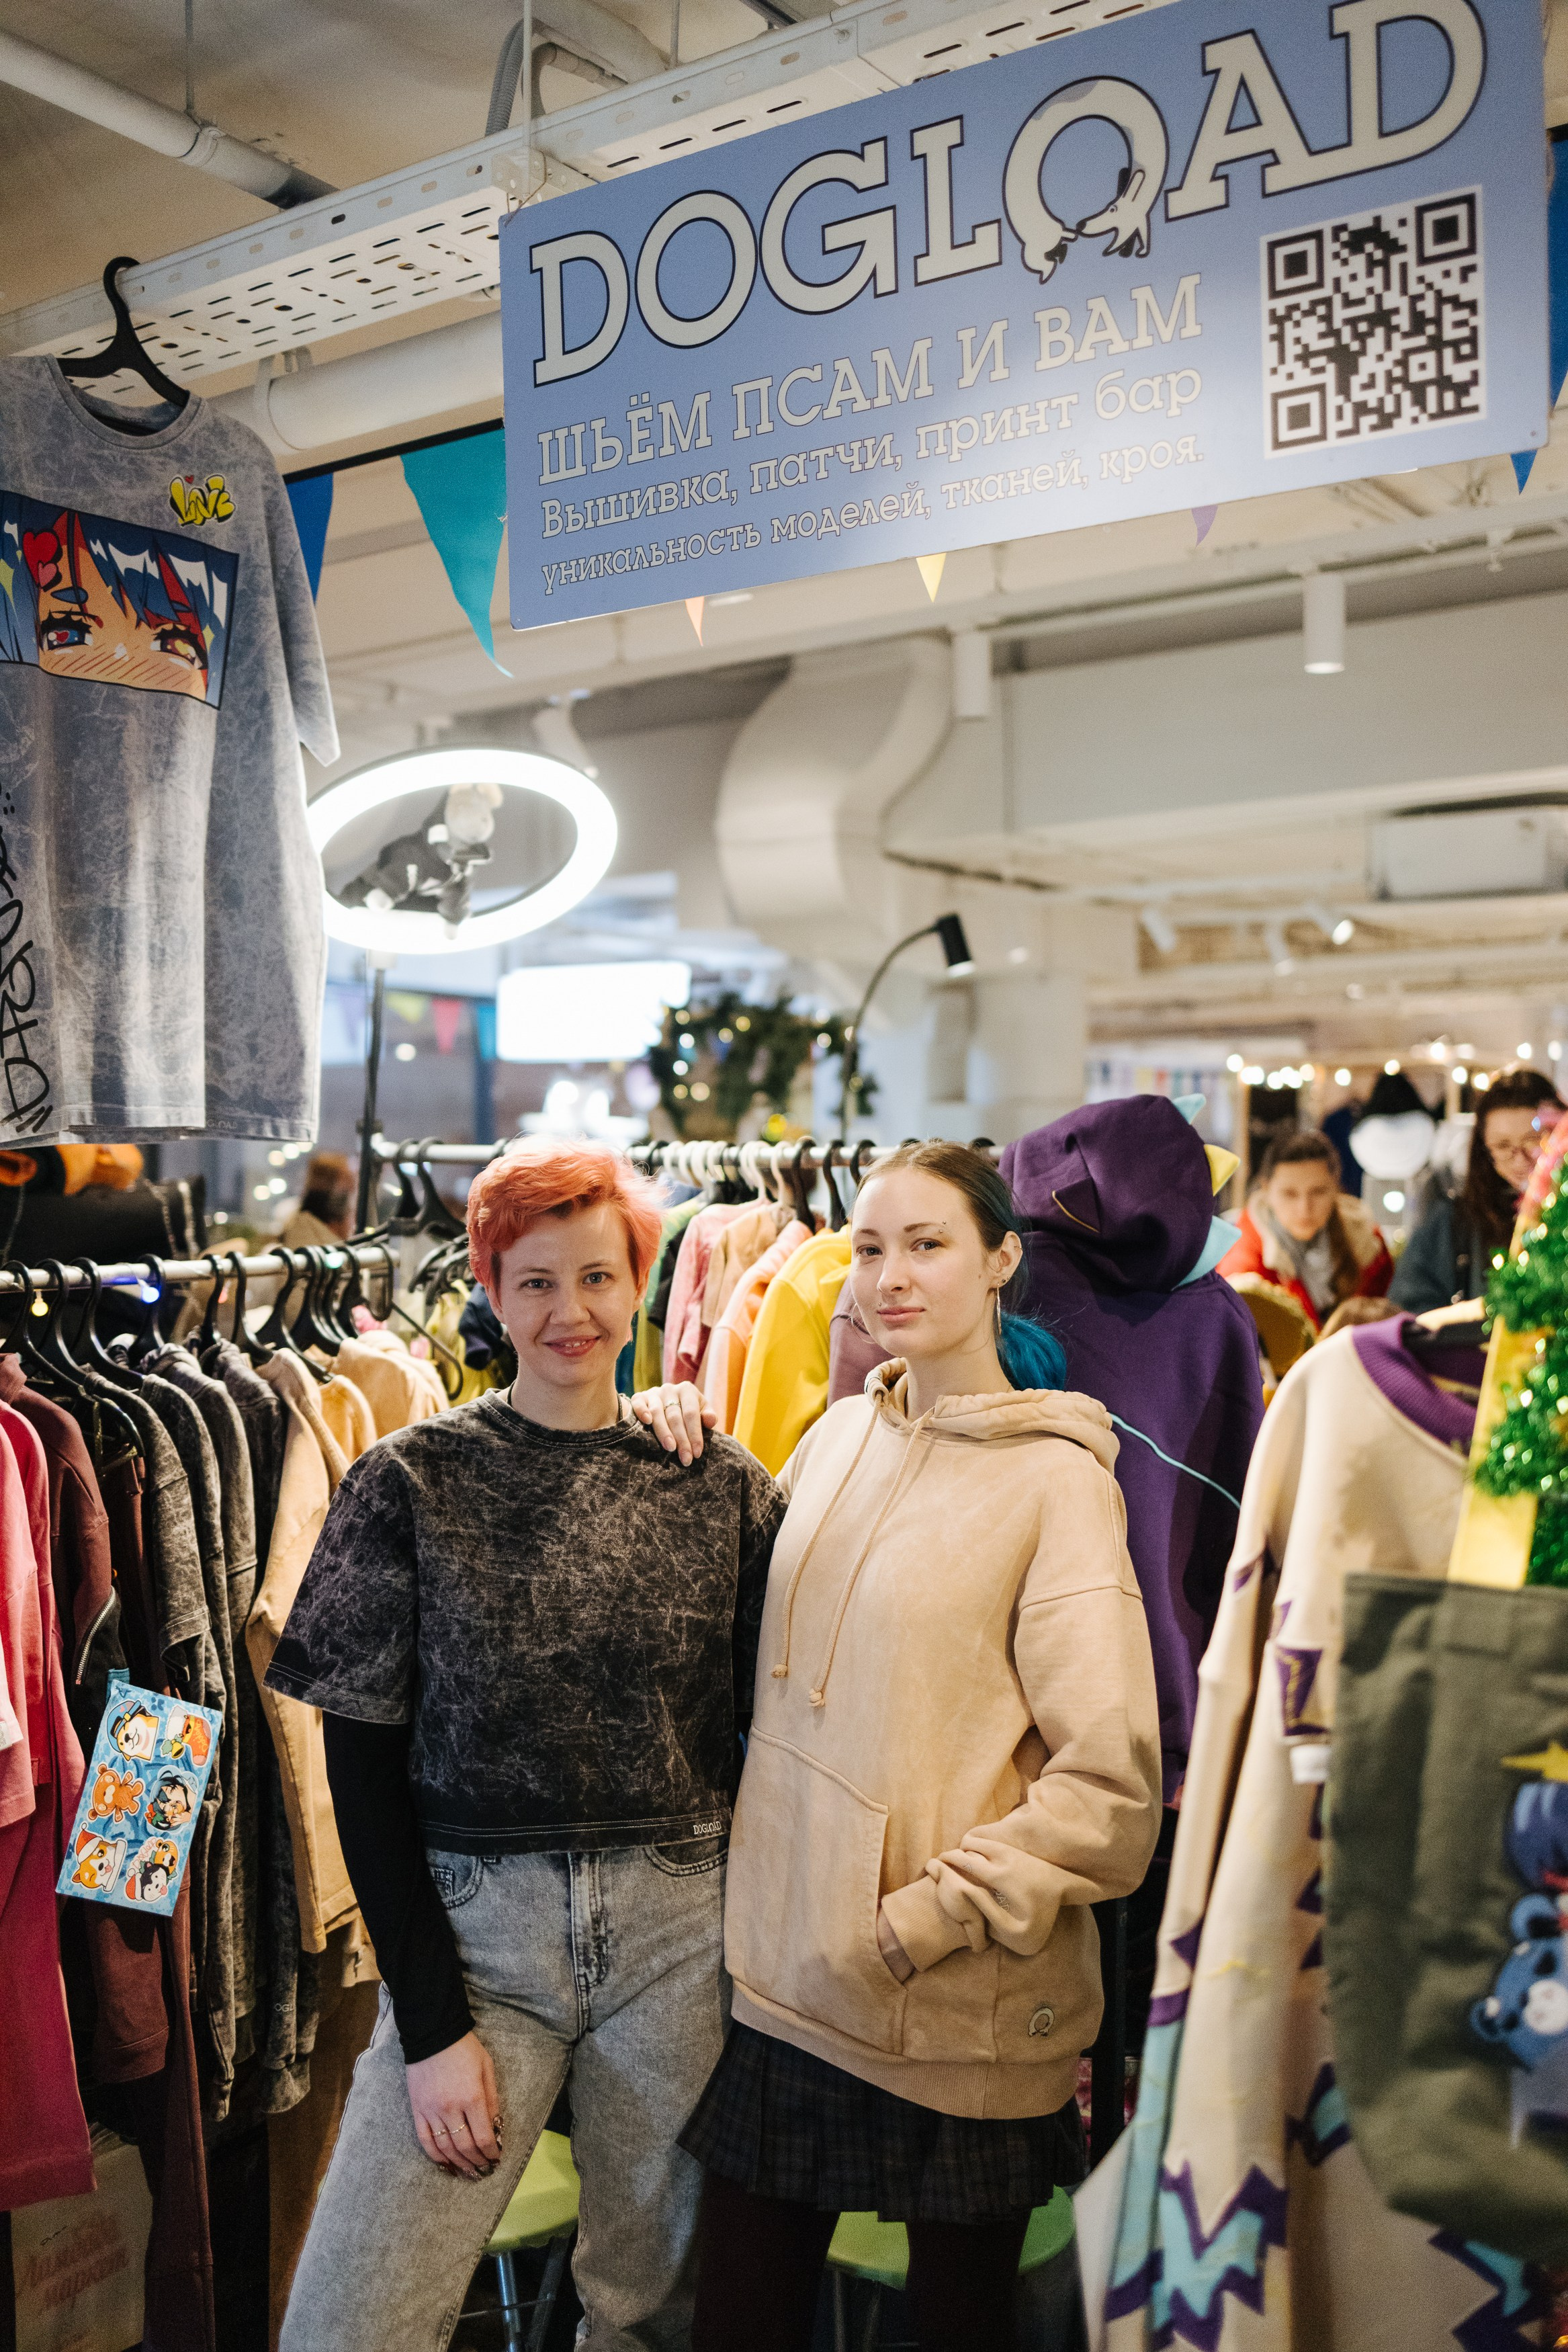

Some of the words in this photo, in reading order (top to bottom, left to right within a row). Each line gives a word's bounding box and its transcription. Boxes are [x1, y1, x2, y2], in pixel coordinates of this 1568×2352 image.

[529, 0, 1487, 388] DOGLOAD
[538, 391, 712, 485] ШЬЁМ
[732, 337, 934, 440] ПСАМ
[957, 319, 1010, 389] И
[1034, 273, 1202, 372] ВАМ
[541, 469, 738, 538] Вышивка,
[750, 433, 902, 494] патчи,
[916, 393, 1079, 462] принт
[1094, 368, 1203, 420] бар
[541, 523, 762, 596] уникальность
[771, 481, 931, 543] моделей,
[941, 450, 1088, 509] тканей,
[1099, 434, 1205, 485] кроя.
[693, 1820, 722, 1835] DOGLOAD
